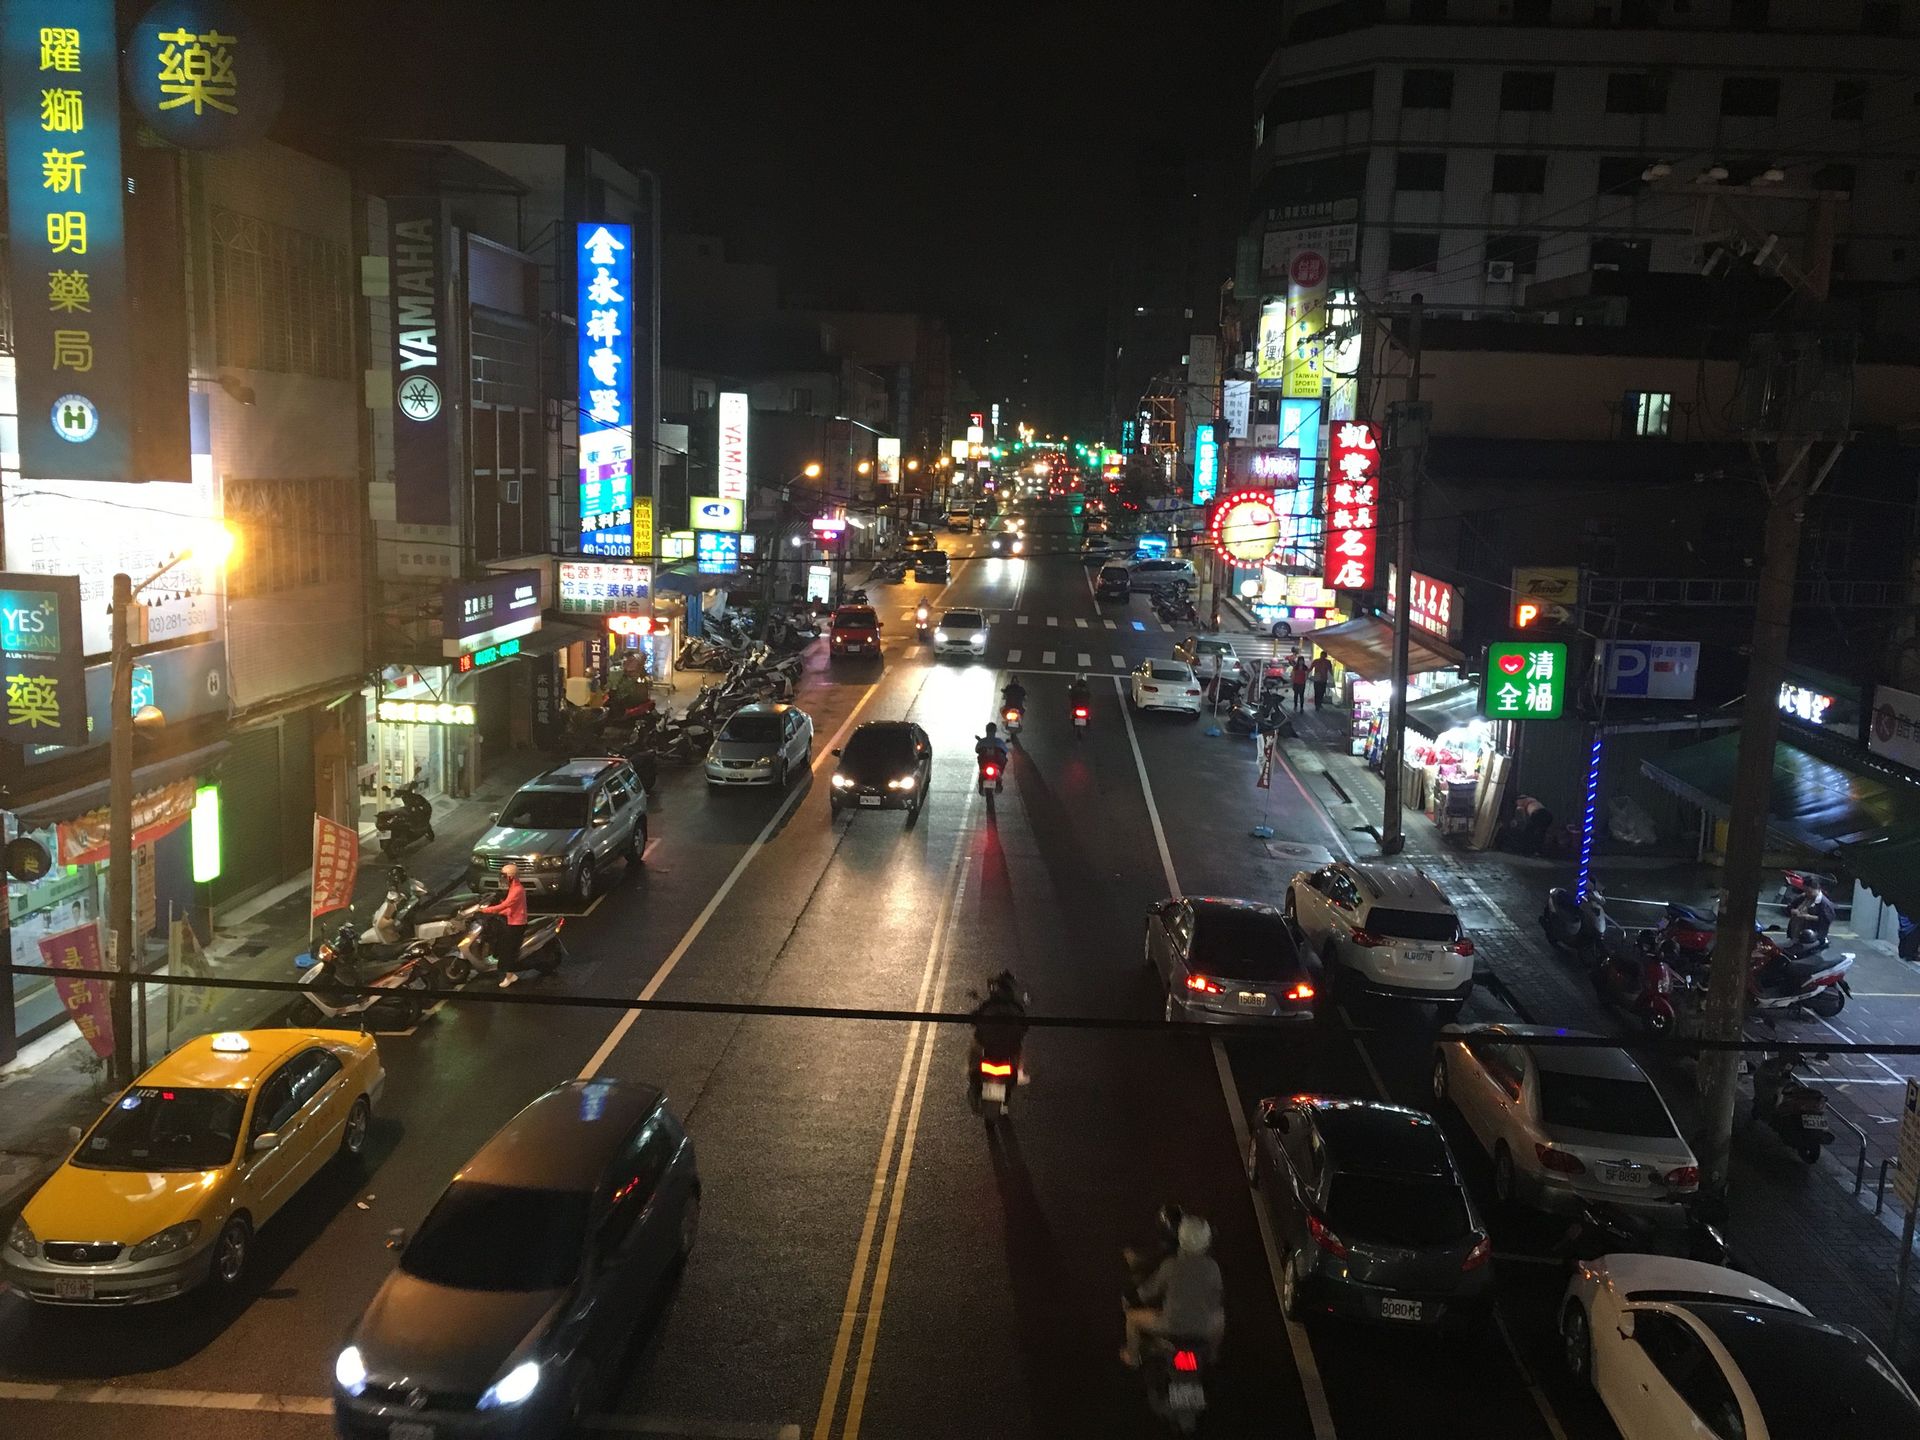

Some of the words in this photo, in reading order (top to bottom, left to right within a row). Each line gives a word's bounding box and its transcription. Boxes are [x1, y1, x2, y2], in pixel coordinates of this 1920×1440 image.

[158, 28, 238, 115] 藥
[39, 28, 93, 371] 躍獅新明藥局
[398, 217, 437, 370] YAMAHA
[724, 423, 742, 498] YAMAH
[583, 544, 631, 556] 491-0008
[562, 580, 651, 599] 冷氣安裝保養
[1519, 605, 1537, 627] P
[5, 632, 57, 648] CHAIN
[1609, 648, 1647, 690] P
[6, 674, 61, 729] 藥
[132, 685, 147, 708] ES
